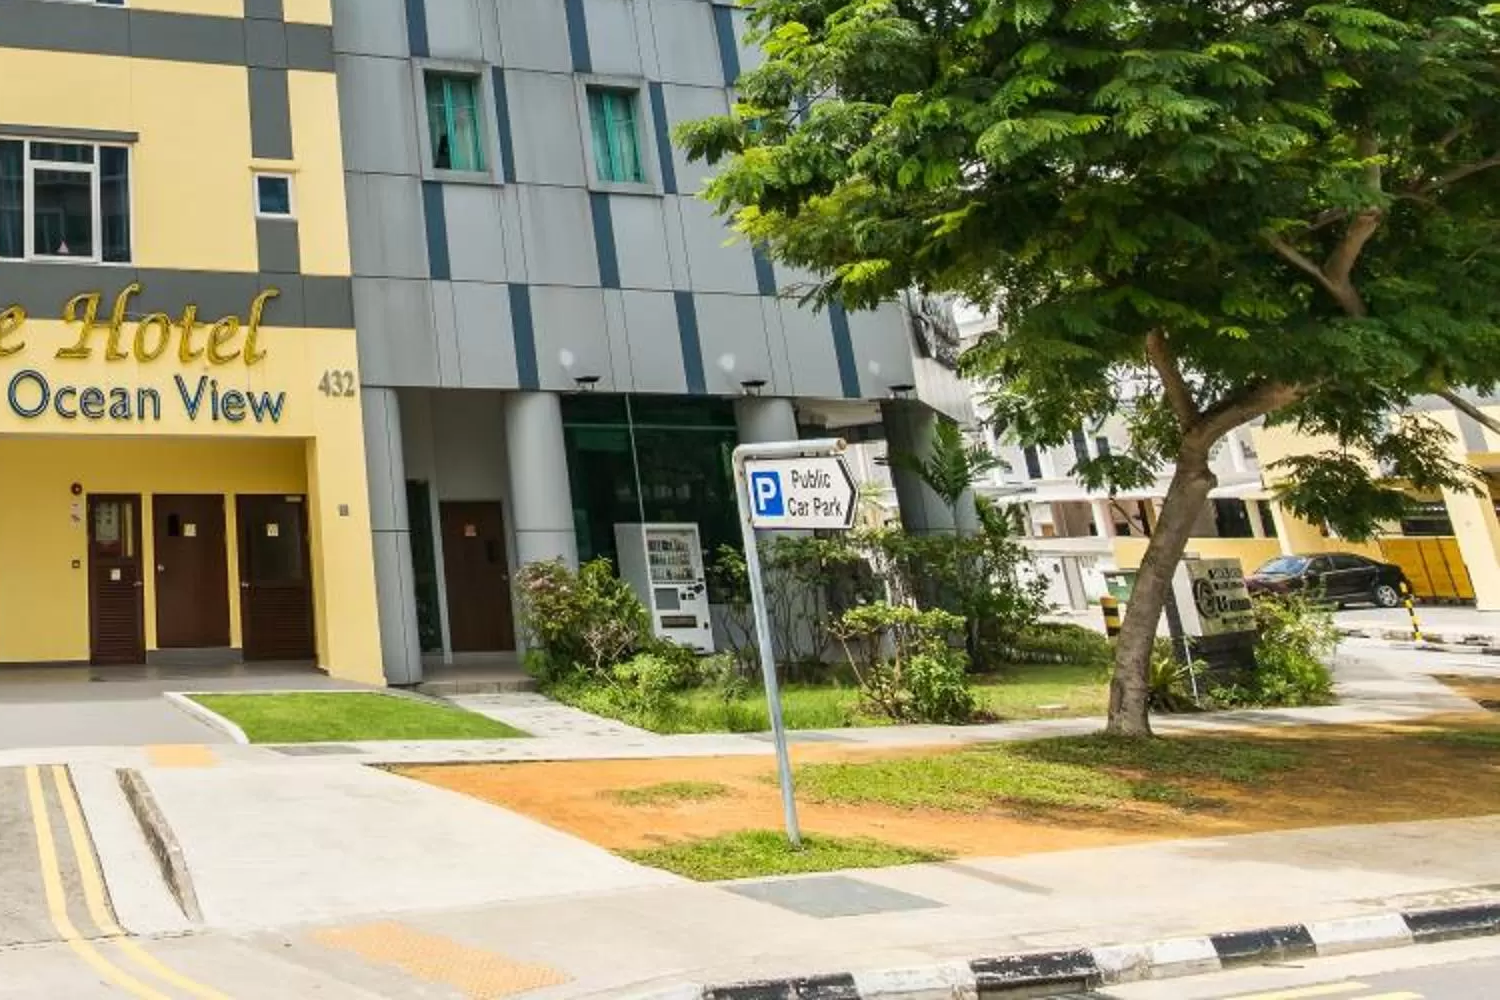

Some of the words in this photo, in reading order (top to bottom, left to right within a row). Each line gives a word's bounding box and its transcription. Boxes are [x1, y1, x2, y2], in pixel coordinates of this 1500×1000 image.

[55, 282, 281, 366] Hotel
[8, 369, 161, 421] Ocean
[174, 374, 286, 423] View
[318, 370, 356, 398] 432
[791, 469, 831, 489] Public
[787, 497, 809, 517] Car
[813, 497, 843, 517] Park
